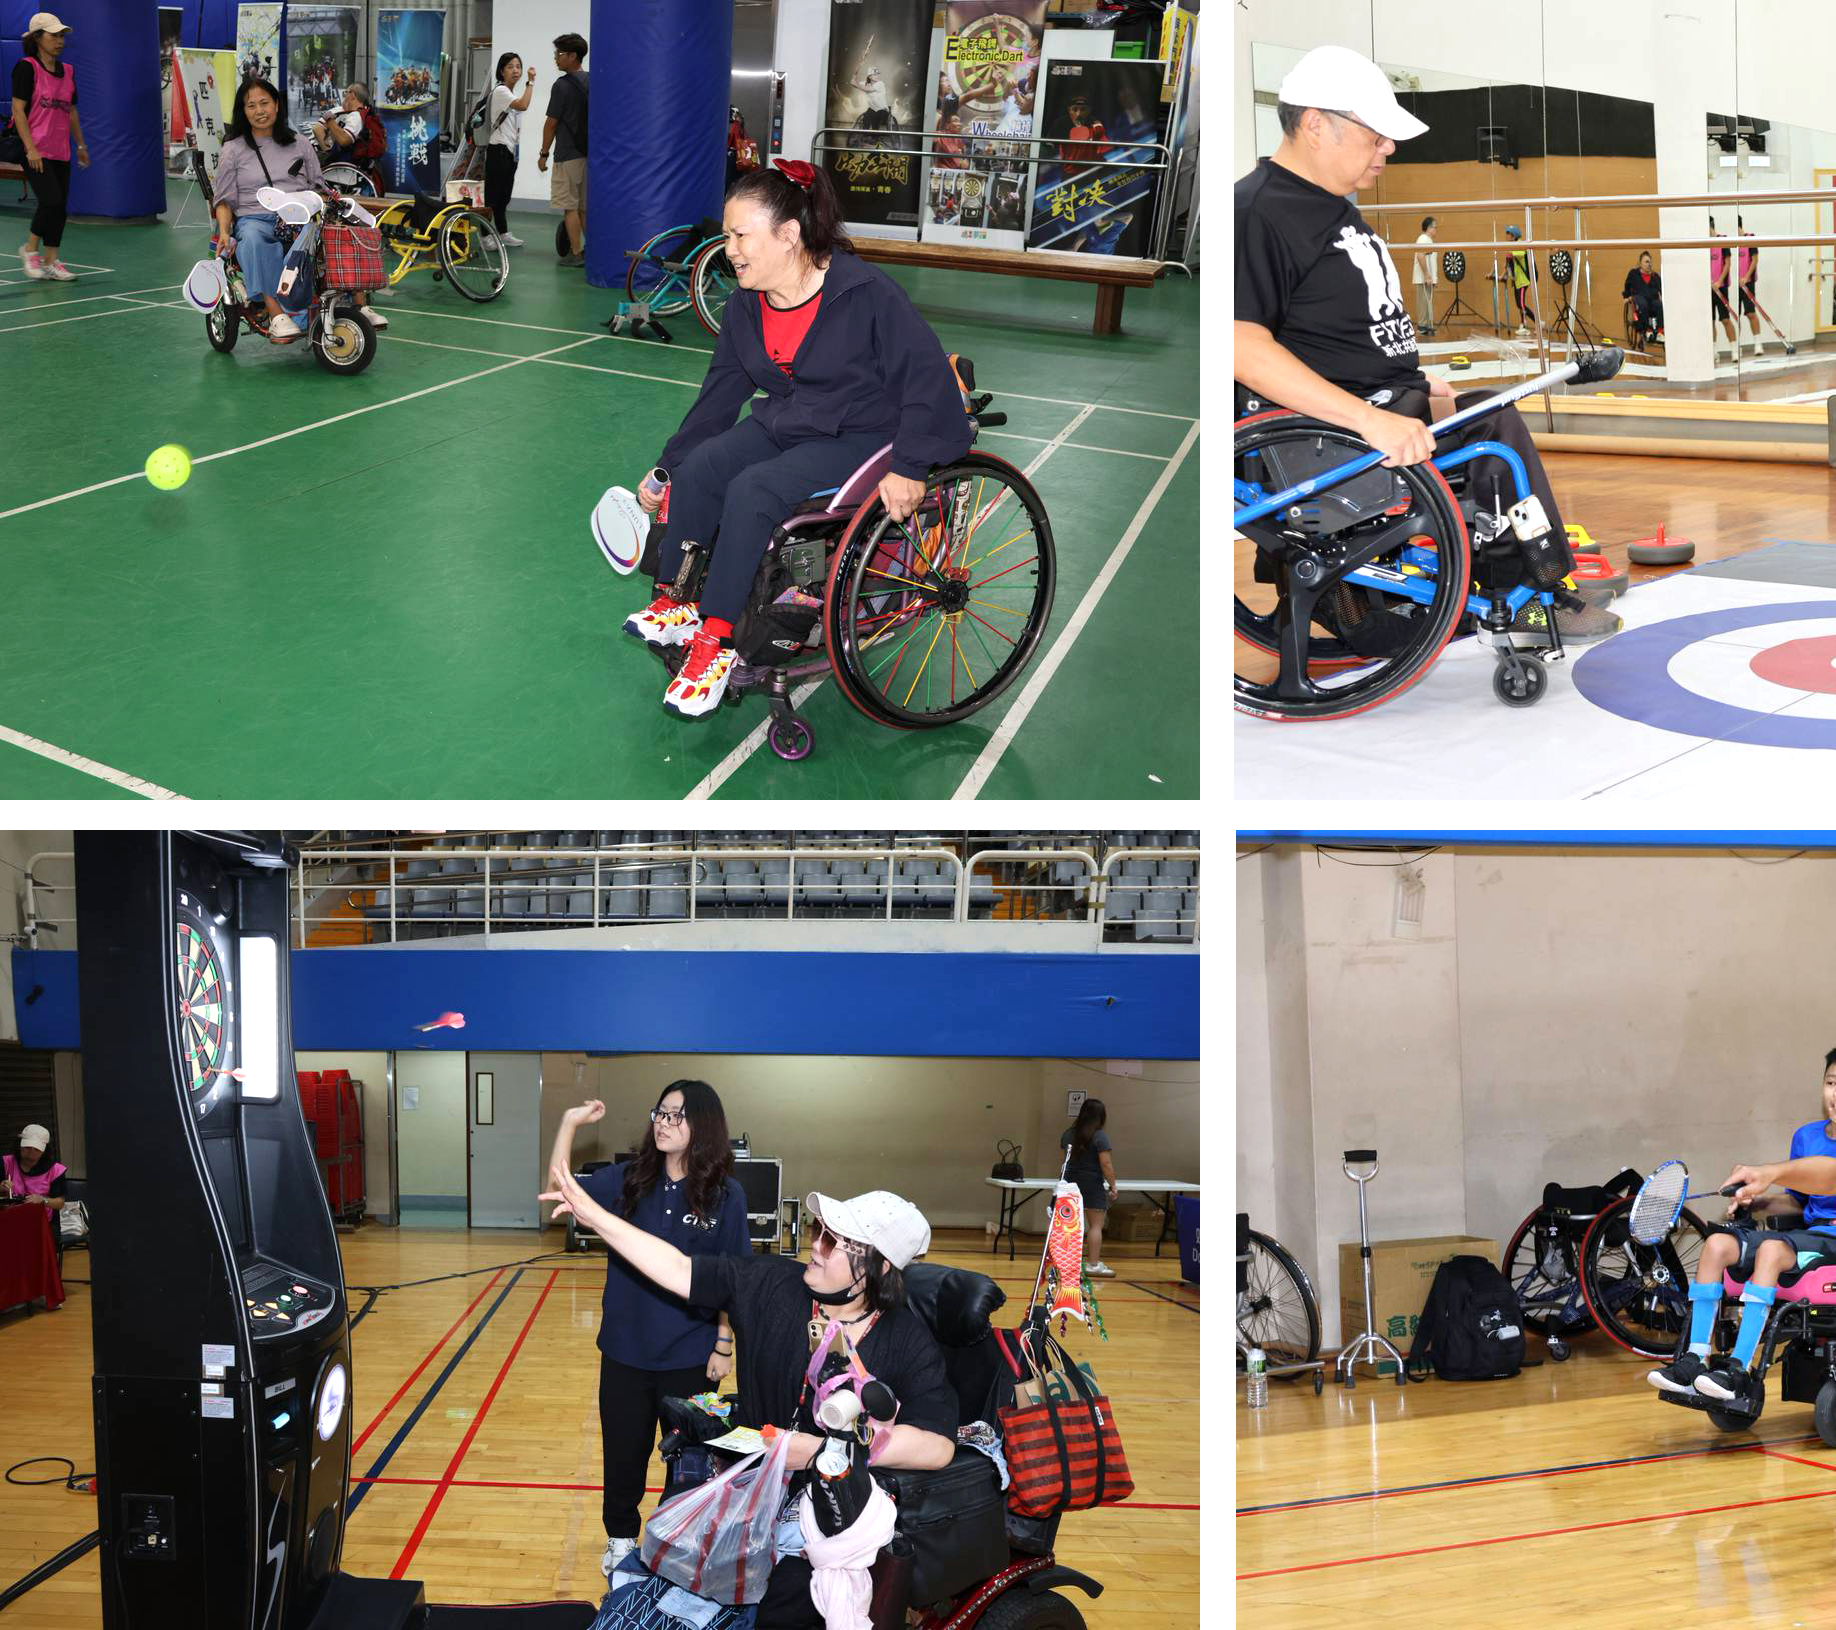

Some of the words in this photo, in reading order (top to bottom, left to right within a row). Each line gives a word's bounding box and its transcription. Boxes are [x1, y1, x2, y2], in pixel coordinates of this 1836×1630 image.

[1002, 50, 1023, 62] Dart
[408, 115, 429, 166] 挑戰
[274, 1384, 286, 1393] BILL
